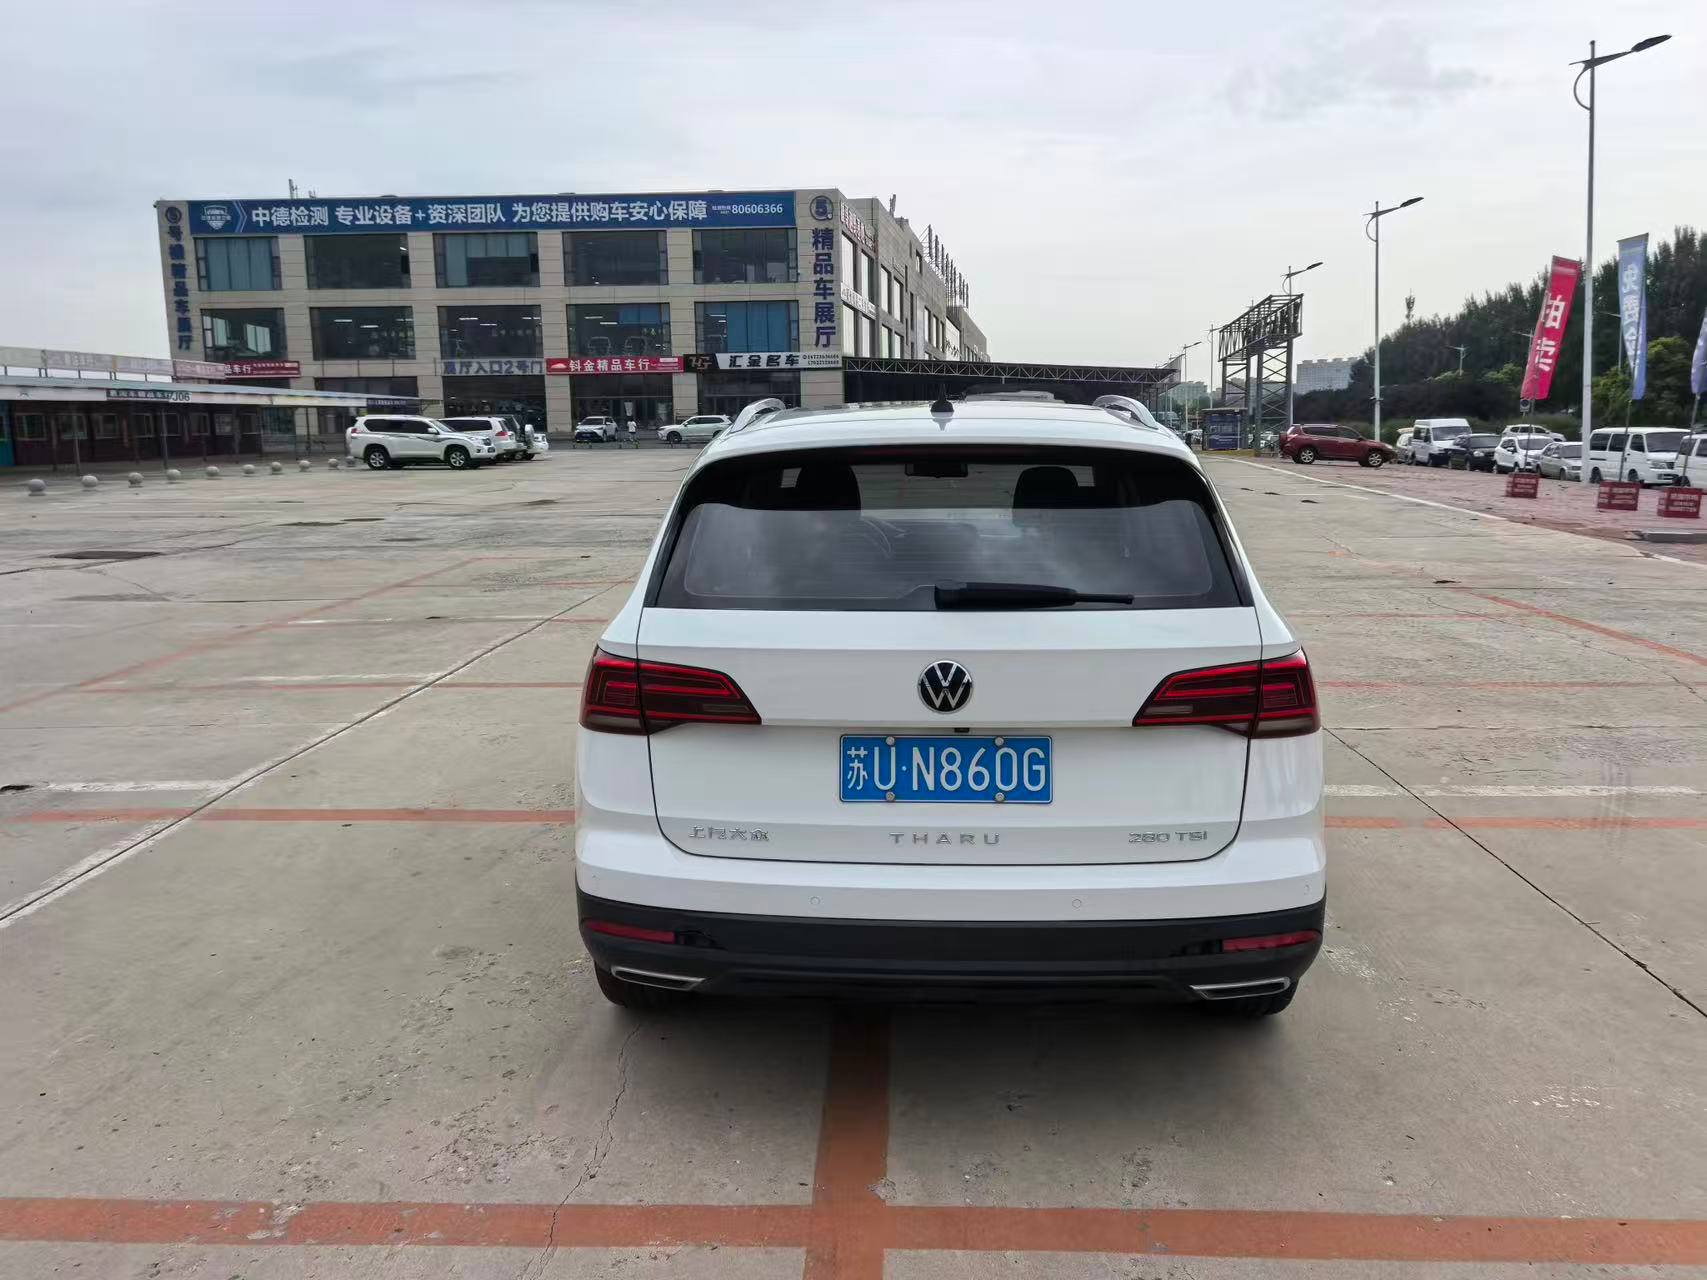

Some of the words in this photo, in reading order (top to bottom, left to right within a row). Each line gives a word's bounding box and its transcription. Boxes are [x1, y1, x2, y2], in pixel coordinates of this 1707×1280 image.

[252, 206, 329, 228] 中德检测
[335, 203, 505, 226] 专业设备+资深团队
[512, 200, 707, 223] 为您提供购车安心保障
[731, 203, 783, 214] 80606366
[812, 227, 836, 348] 精品车展厅
[443, 359, 543, 375] 展厅入口2号门
[728, 353, 800, 368] 汇金名车
[888, 832, 1001, 845] THARU
[1128, 832, 1170, 843] 280
[1175, 830, 1207, 841] TSI
